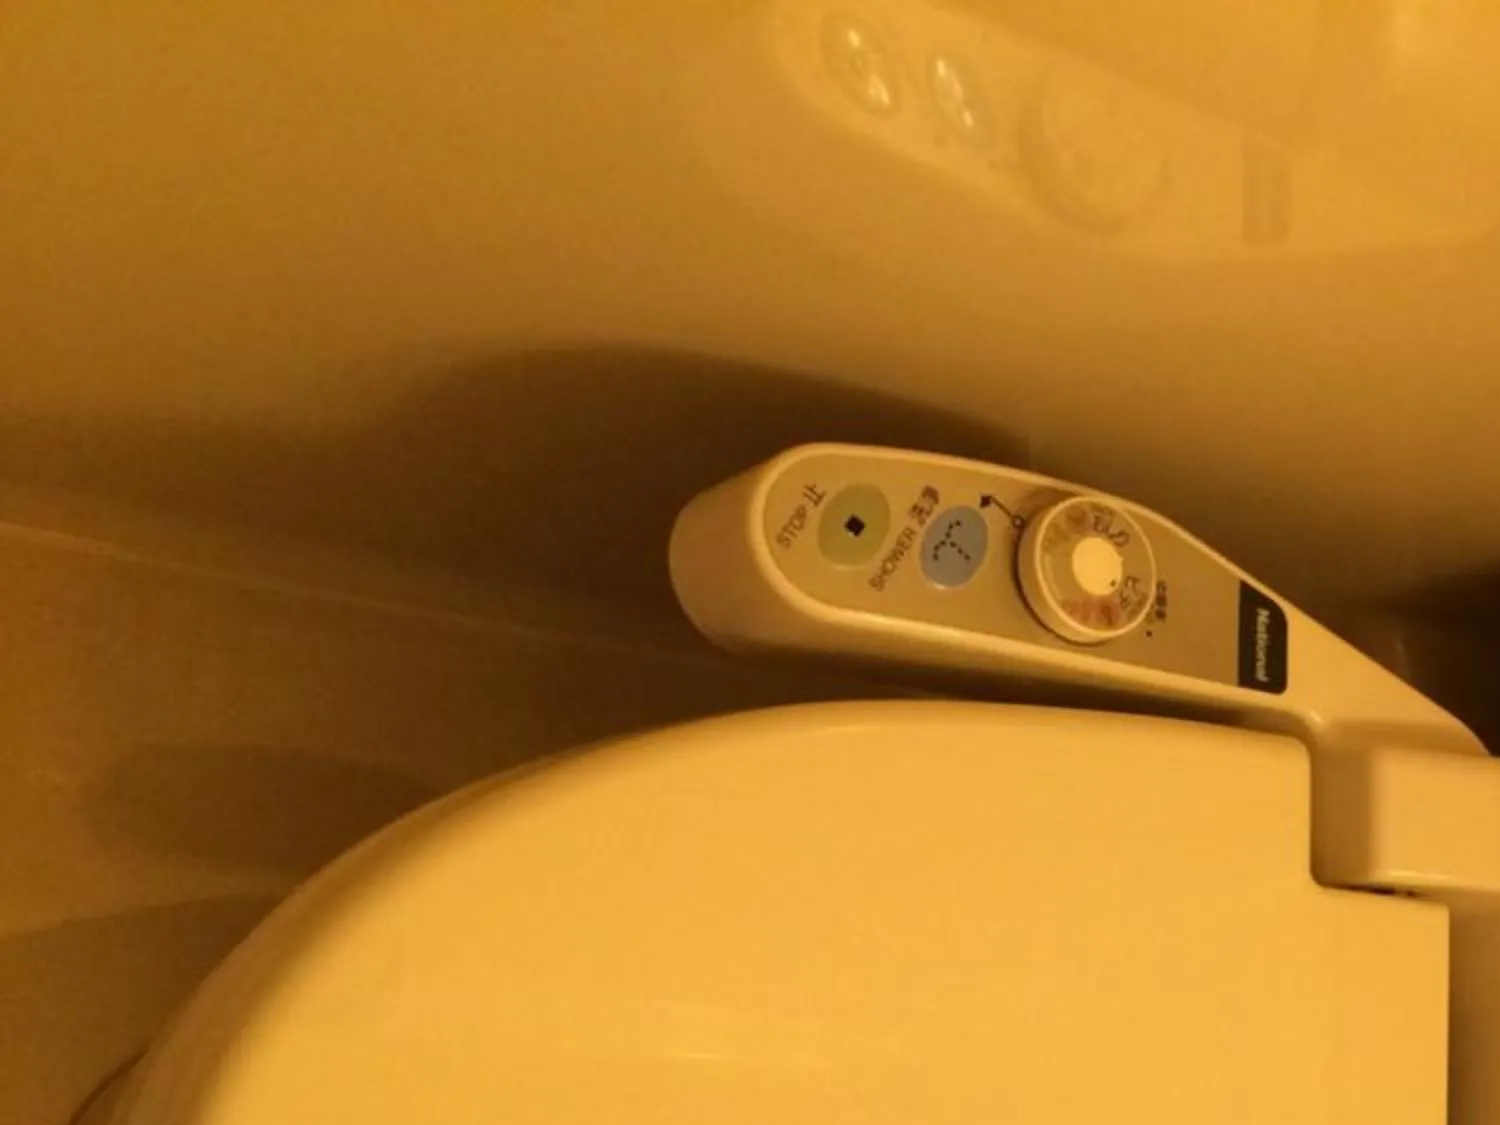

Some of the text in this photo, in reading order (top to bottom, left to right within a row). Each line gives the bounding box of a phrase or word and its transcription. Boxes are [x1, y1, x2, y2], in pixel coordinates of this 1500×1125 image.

[776, 507, 812, 550] STOP
[869, 524, 916, 592] SHOWER
[1254, 606, 1271, 684] National
